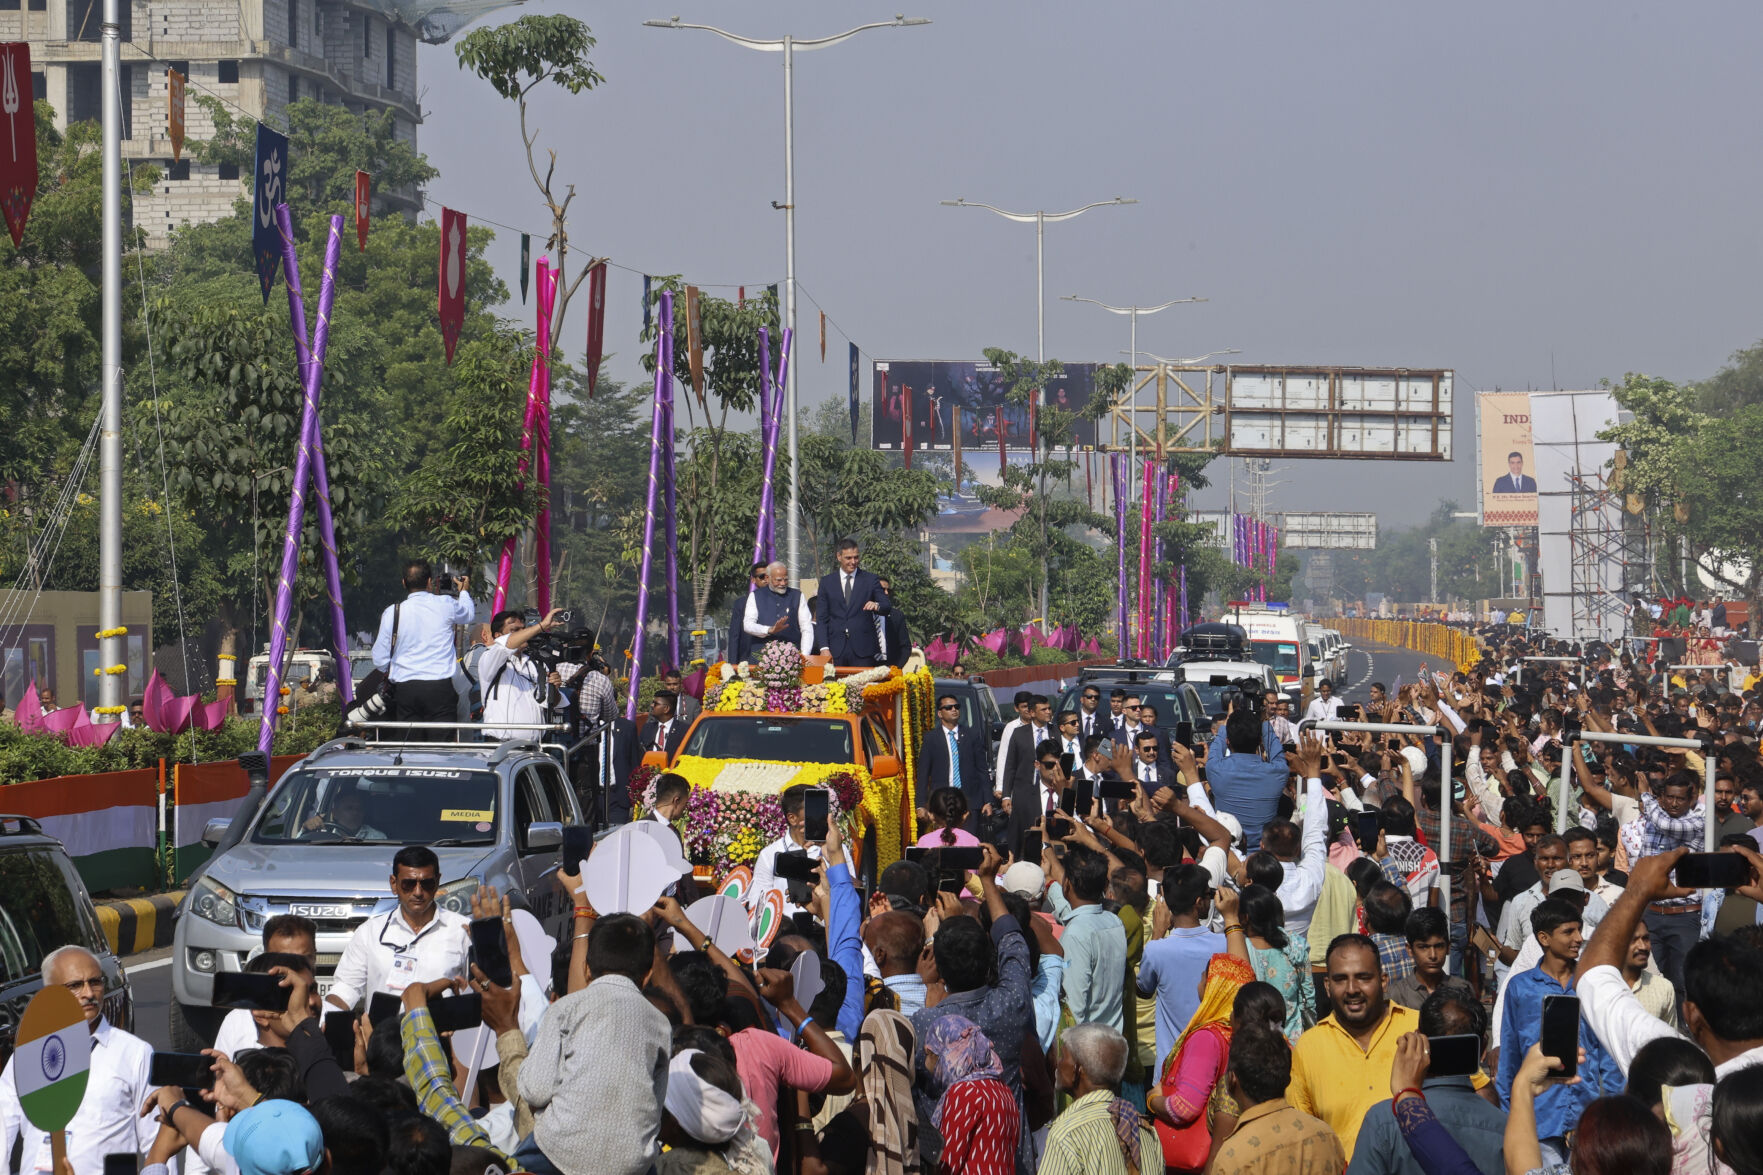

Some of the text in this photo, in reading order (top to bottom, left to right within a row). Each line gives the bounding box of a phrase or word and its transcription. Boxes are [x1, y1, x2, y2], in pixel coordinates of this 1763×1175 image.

[328, 769, 460, 778] TORQUE ISUZU
[292, 906, 347, 916] ISUZU
